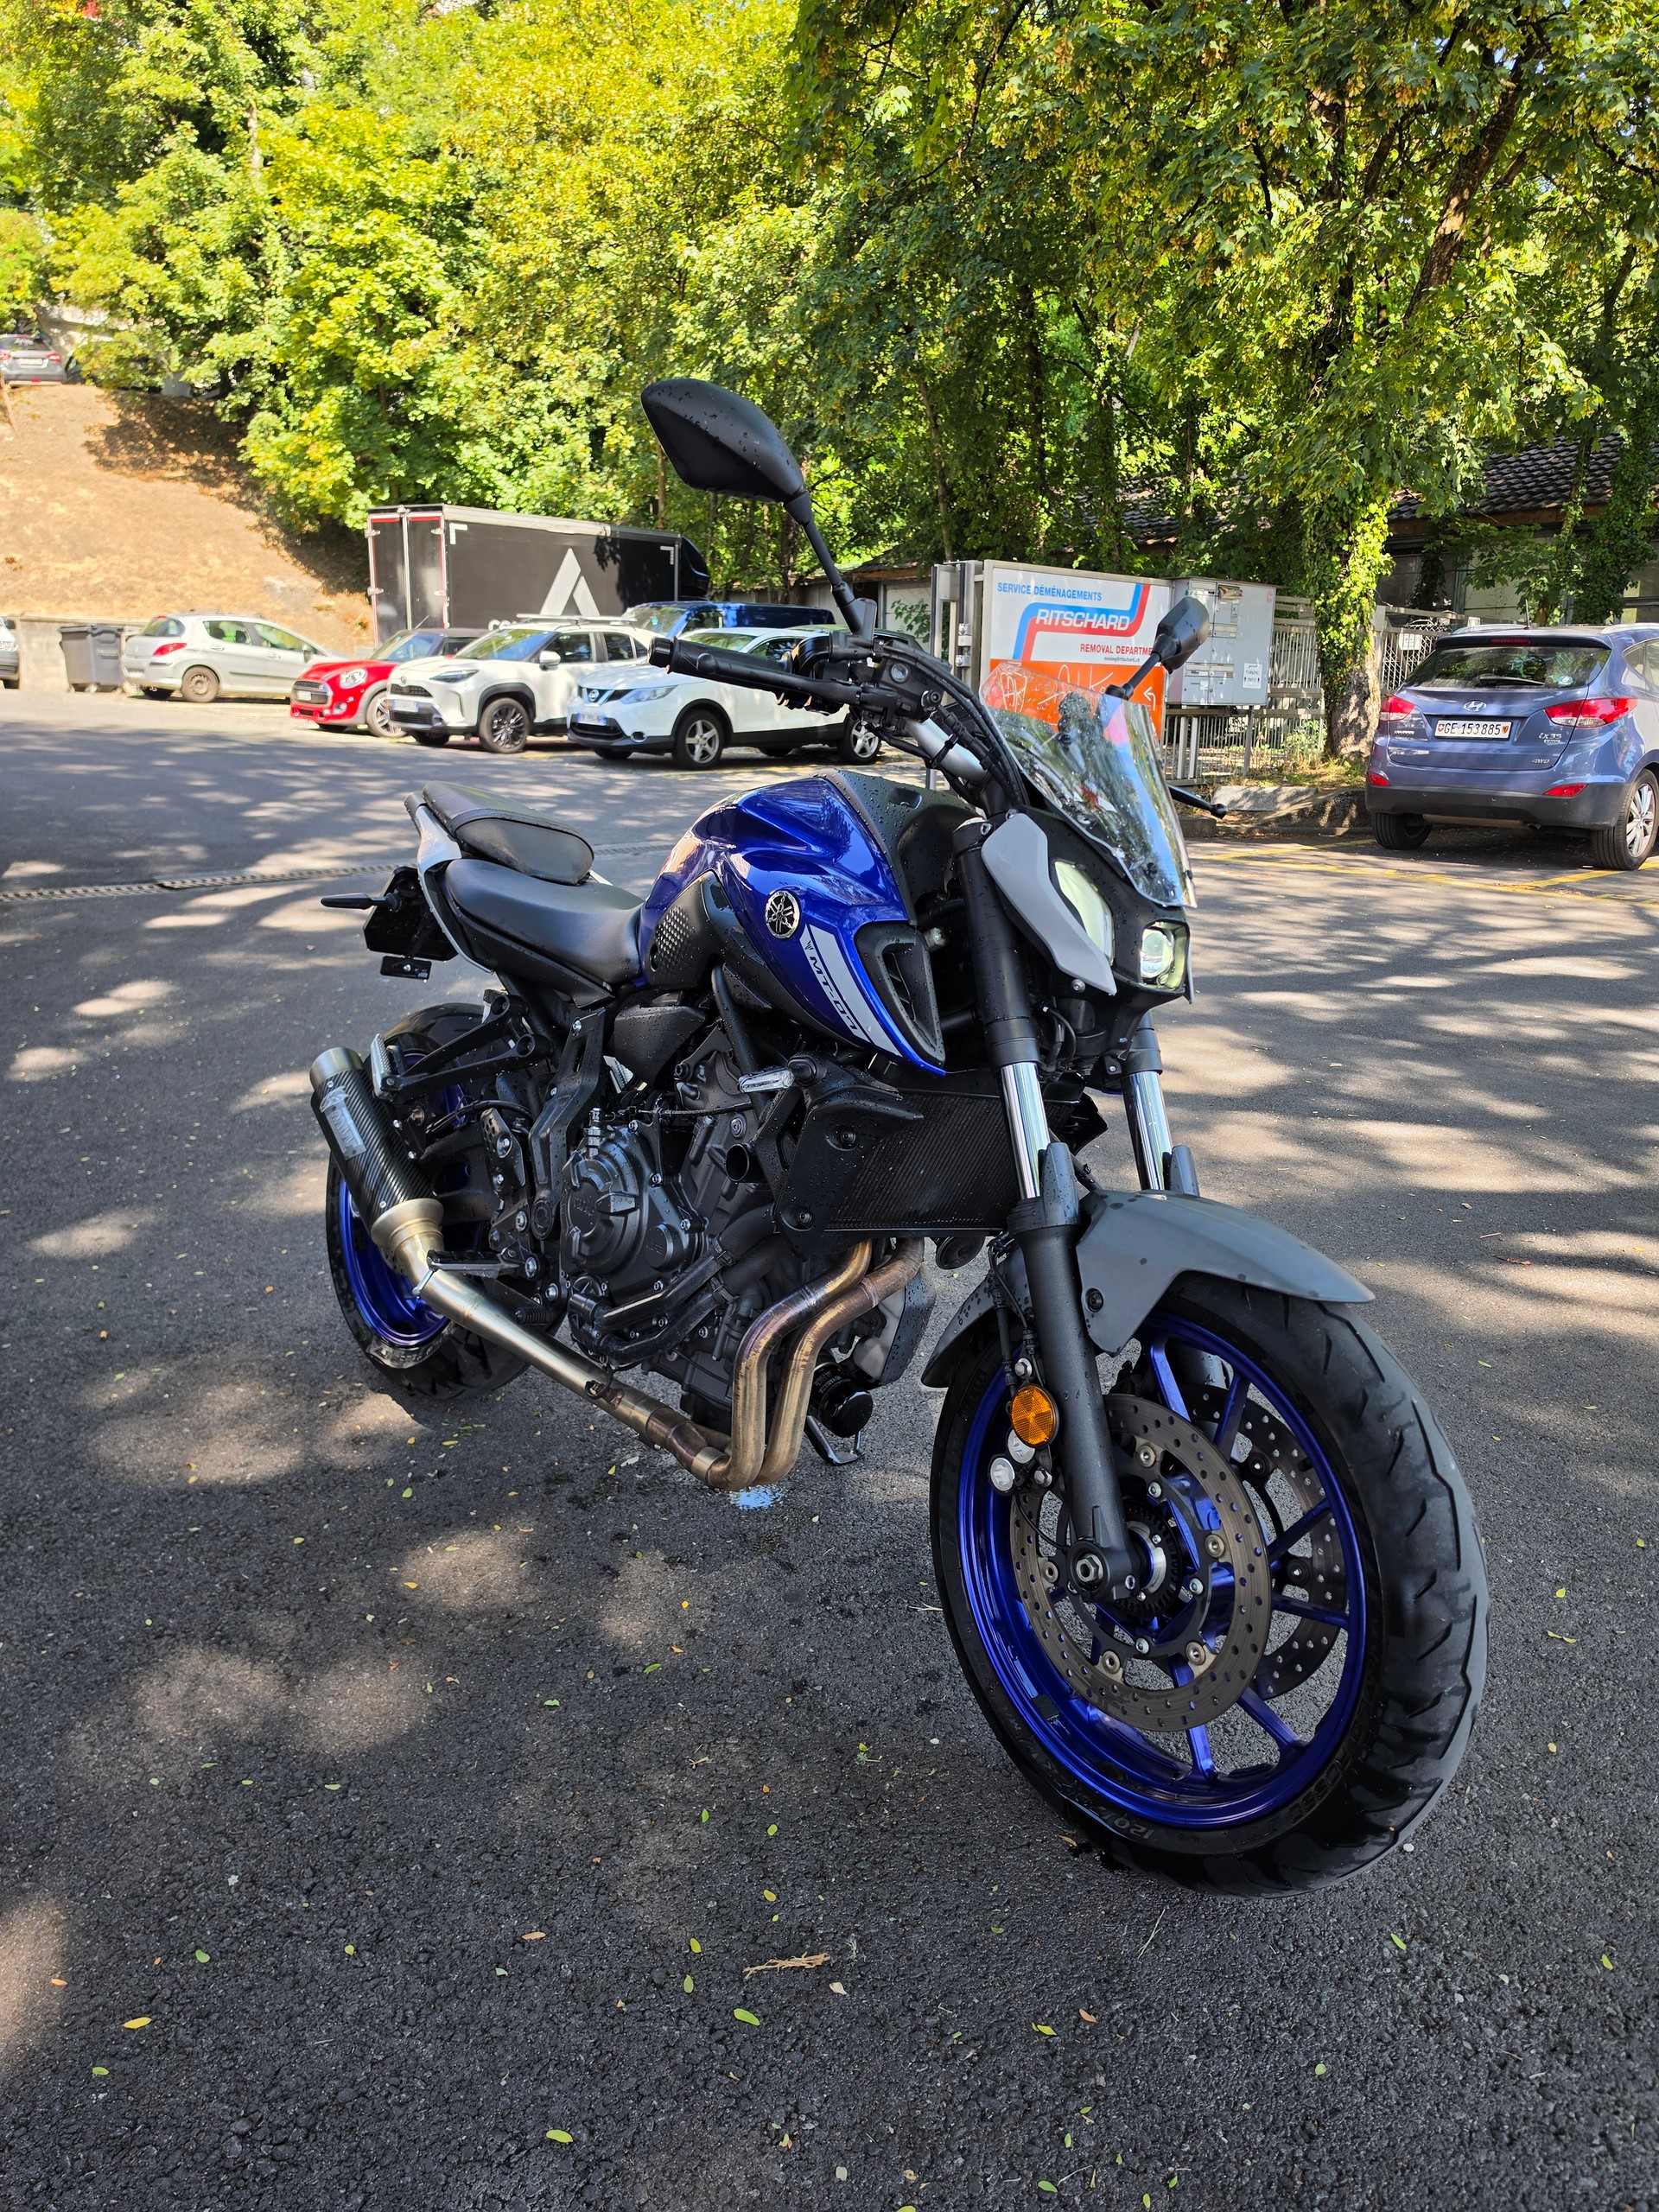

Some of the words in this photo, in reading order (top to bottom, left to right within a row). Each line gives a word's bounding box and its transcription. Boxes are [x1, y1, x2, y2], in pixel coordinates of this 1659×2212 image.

[997, 582, 1032, 594] SERVICE
[1033, 584, 1103, 601] DÉMÉNAGEMENTS
[1035, 608, 1130, 631] RITSCHARD
[1080, 644, 1114, 654] REMOVAL
[1116, 645, 1154, 656] DEPARTME
[809, 956, 858, 1030] MT-07
